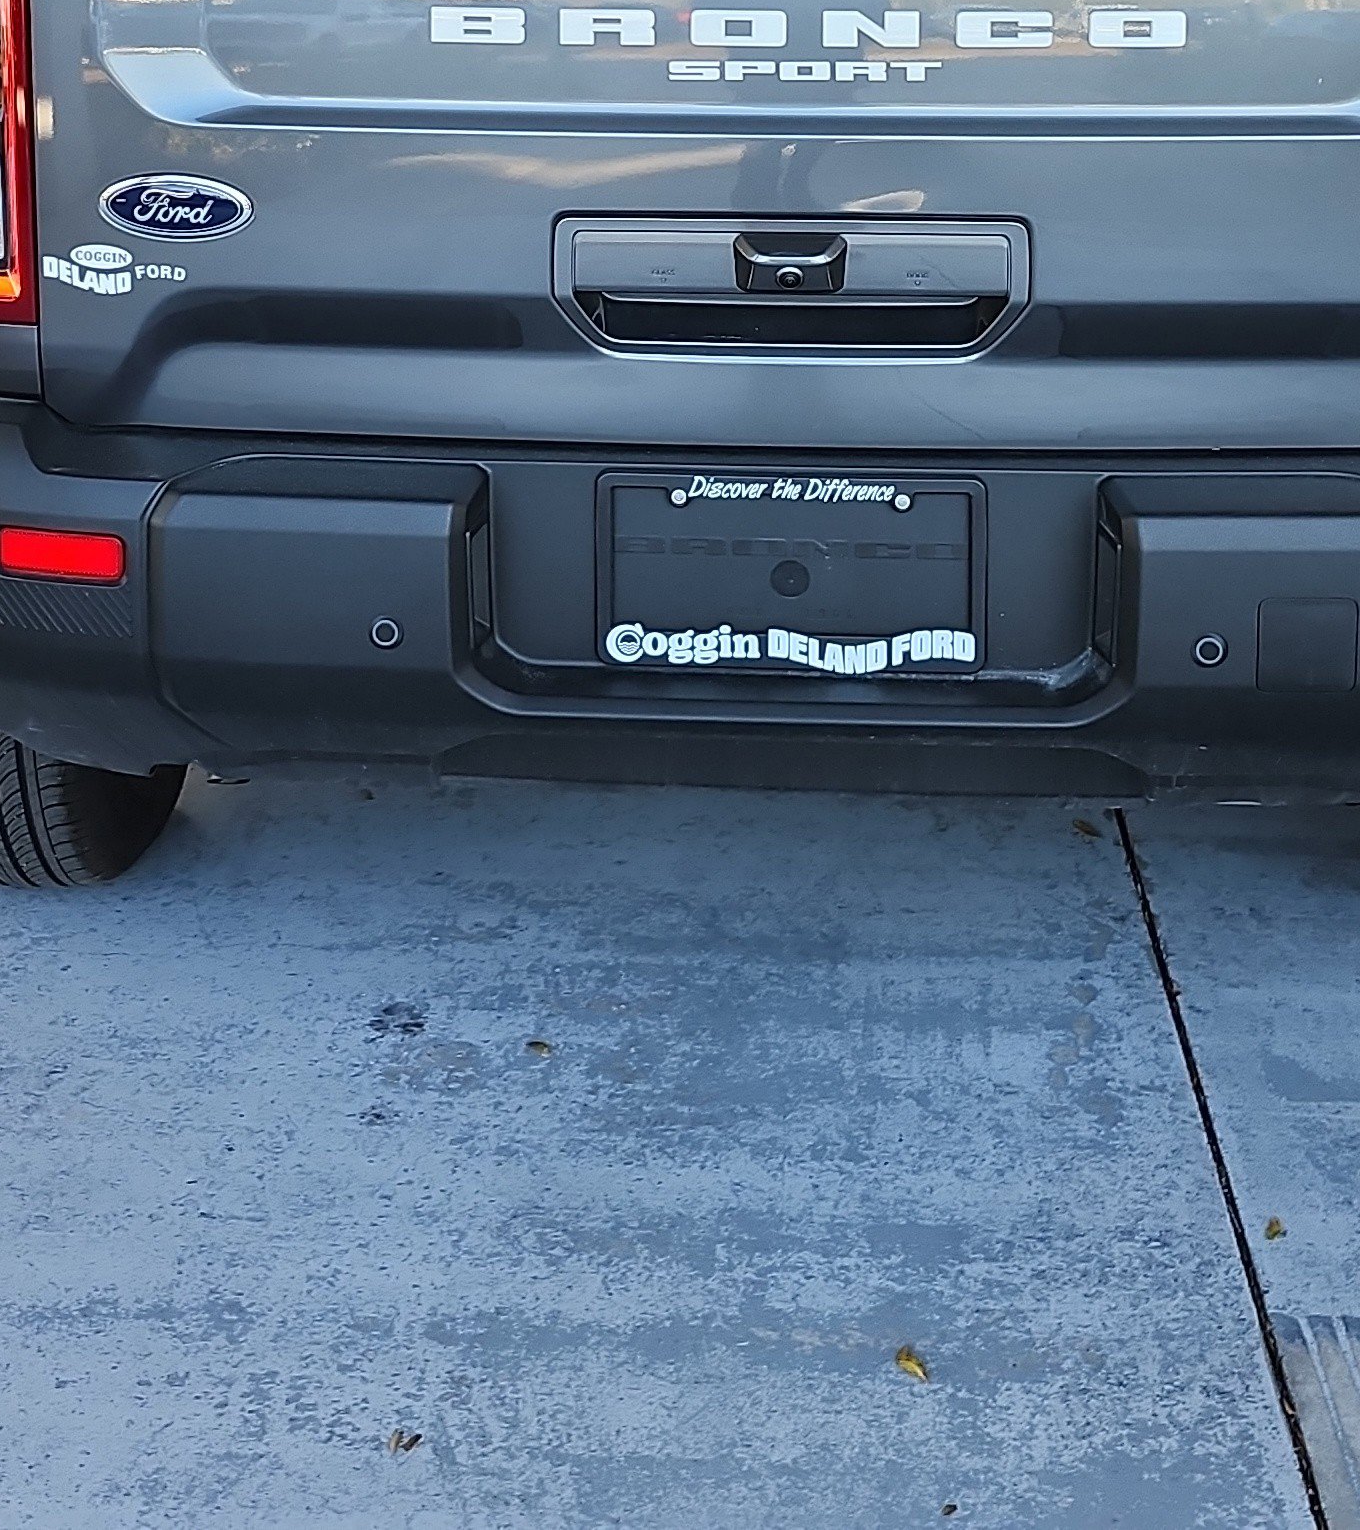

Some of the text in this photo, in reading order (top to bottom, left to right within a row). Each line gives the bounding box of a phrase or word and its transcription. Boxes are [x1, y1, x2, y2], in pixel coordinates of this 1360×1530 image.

[429, 6, 1188, 49] BRONCO
[667, 60, 944, 83] SPORT
[133, 187, 213, 225] Ford
[42, 255, 187, 295] DELAND FORD
[74, 249, 128, 263] COGGIN
[687, 475, 896, 503] Discover the Difference
[605, 622, 976, 674] Coggin DELAND FORD
